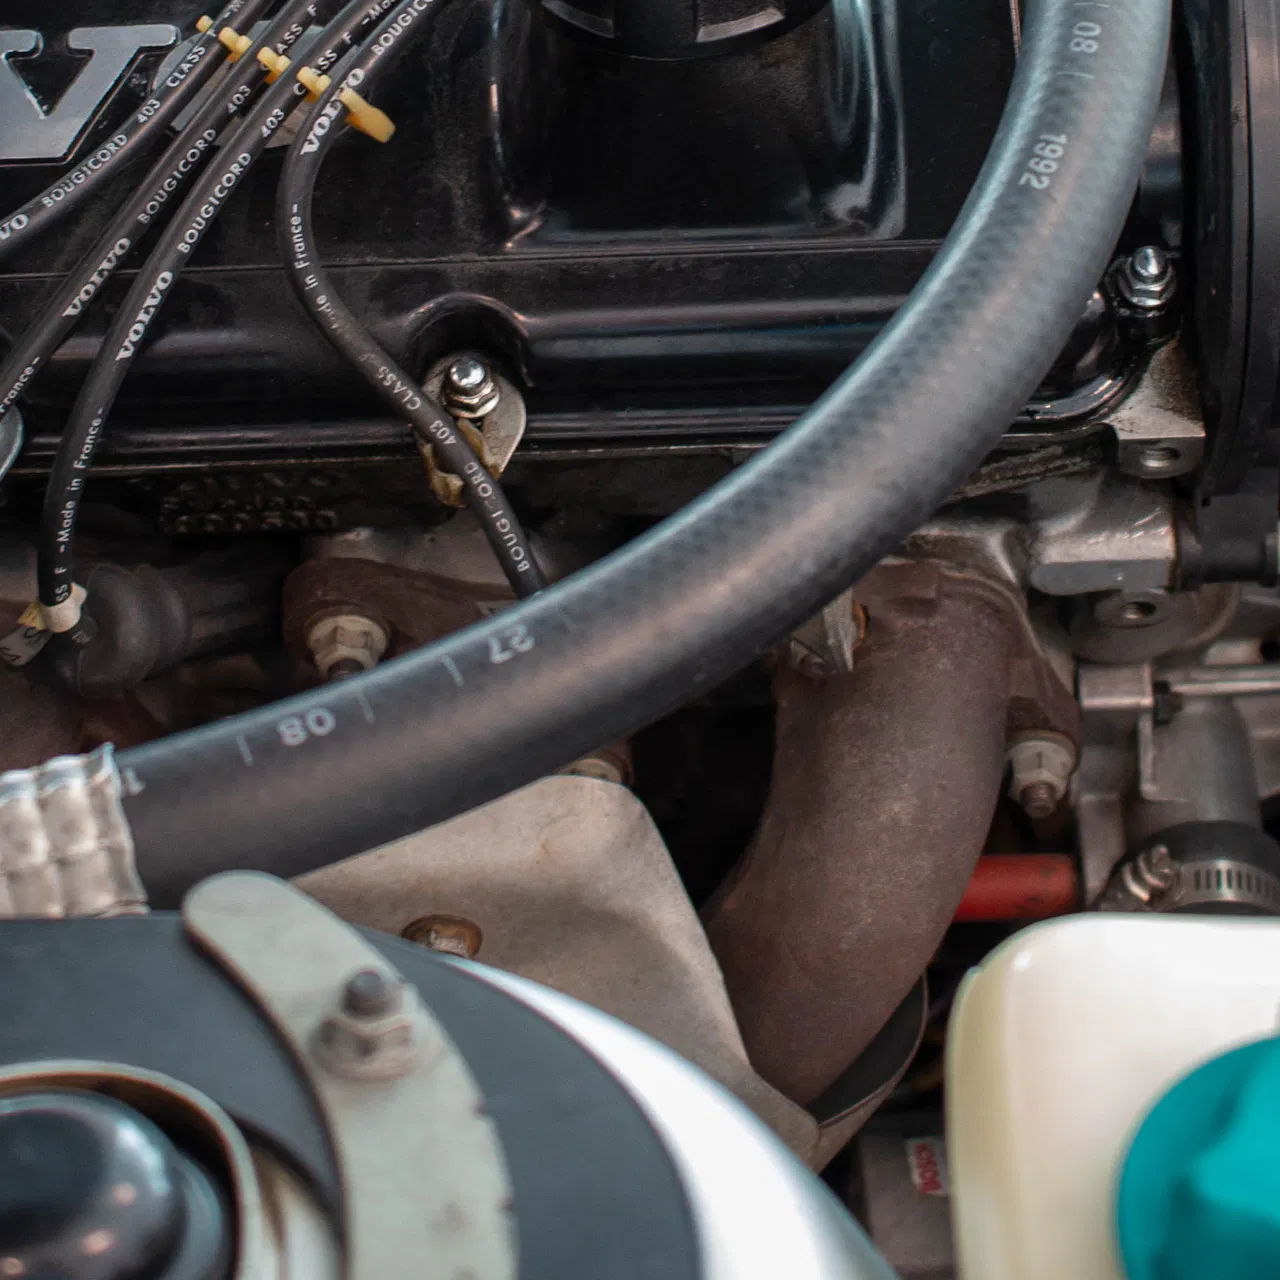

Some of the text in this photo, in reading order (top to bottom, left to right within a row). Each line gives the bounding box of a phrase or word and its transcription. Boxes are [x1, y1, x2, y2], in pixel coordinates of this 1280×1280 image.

[40, 133, 130, 210] BOUGICORD
[136, 98, 162, 125] 403
[165, 44, 207, 88] CLASS
[61, 237, 131, 319] VOLVO
[137, 127, 217, 225] BOUGICORD
[225, 84, 252, 115] 403
[306, 2, 318, 18] F
[1019, 132, 1069, 191] 1992
[114, 269, 174, 361] VOLVO
[176, 151, 253, 255] BOUGICORD
[261, 107, 286, 139] 403
[342, 30, 353, 46] F
[290, 203, 311, 270] France-
[304, 273, 319, 291] in
[376, 365, 421, 411] CLASS
[428, 419, 457, 446] 403
[66, 477, 83, 492] in
[488, 624, 535, 664] 27
